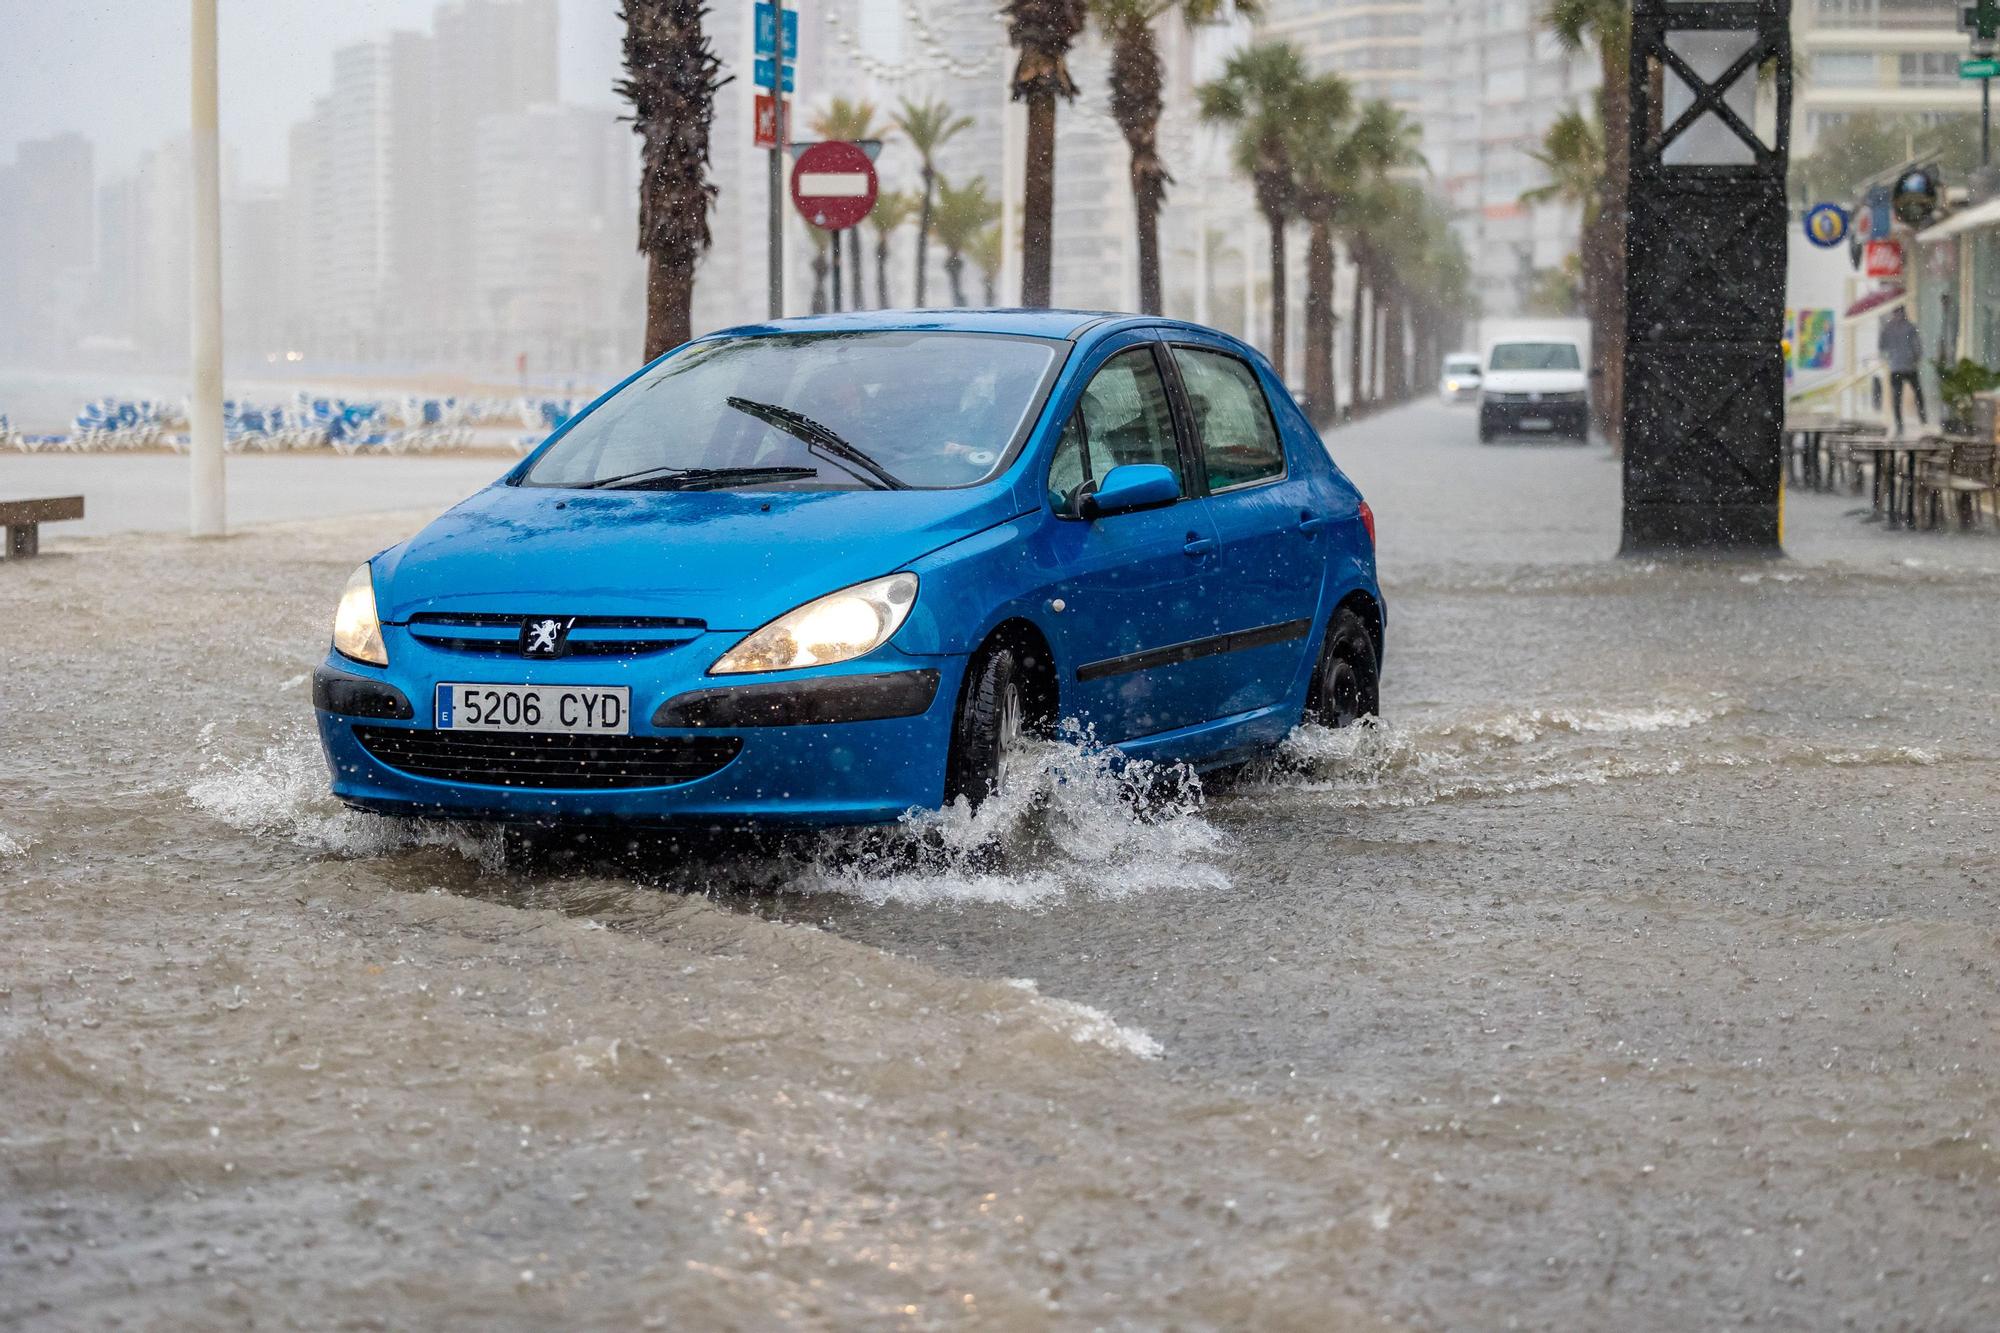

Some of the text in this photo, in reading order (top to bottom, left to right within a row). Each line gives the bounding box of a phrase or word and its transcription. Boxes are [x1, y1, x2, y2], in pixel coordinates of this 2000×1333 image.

[442, 711, 449, 721] E
[464, 690, 621, 727] 5206 CYD
